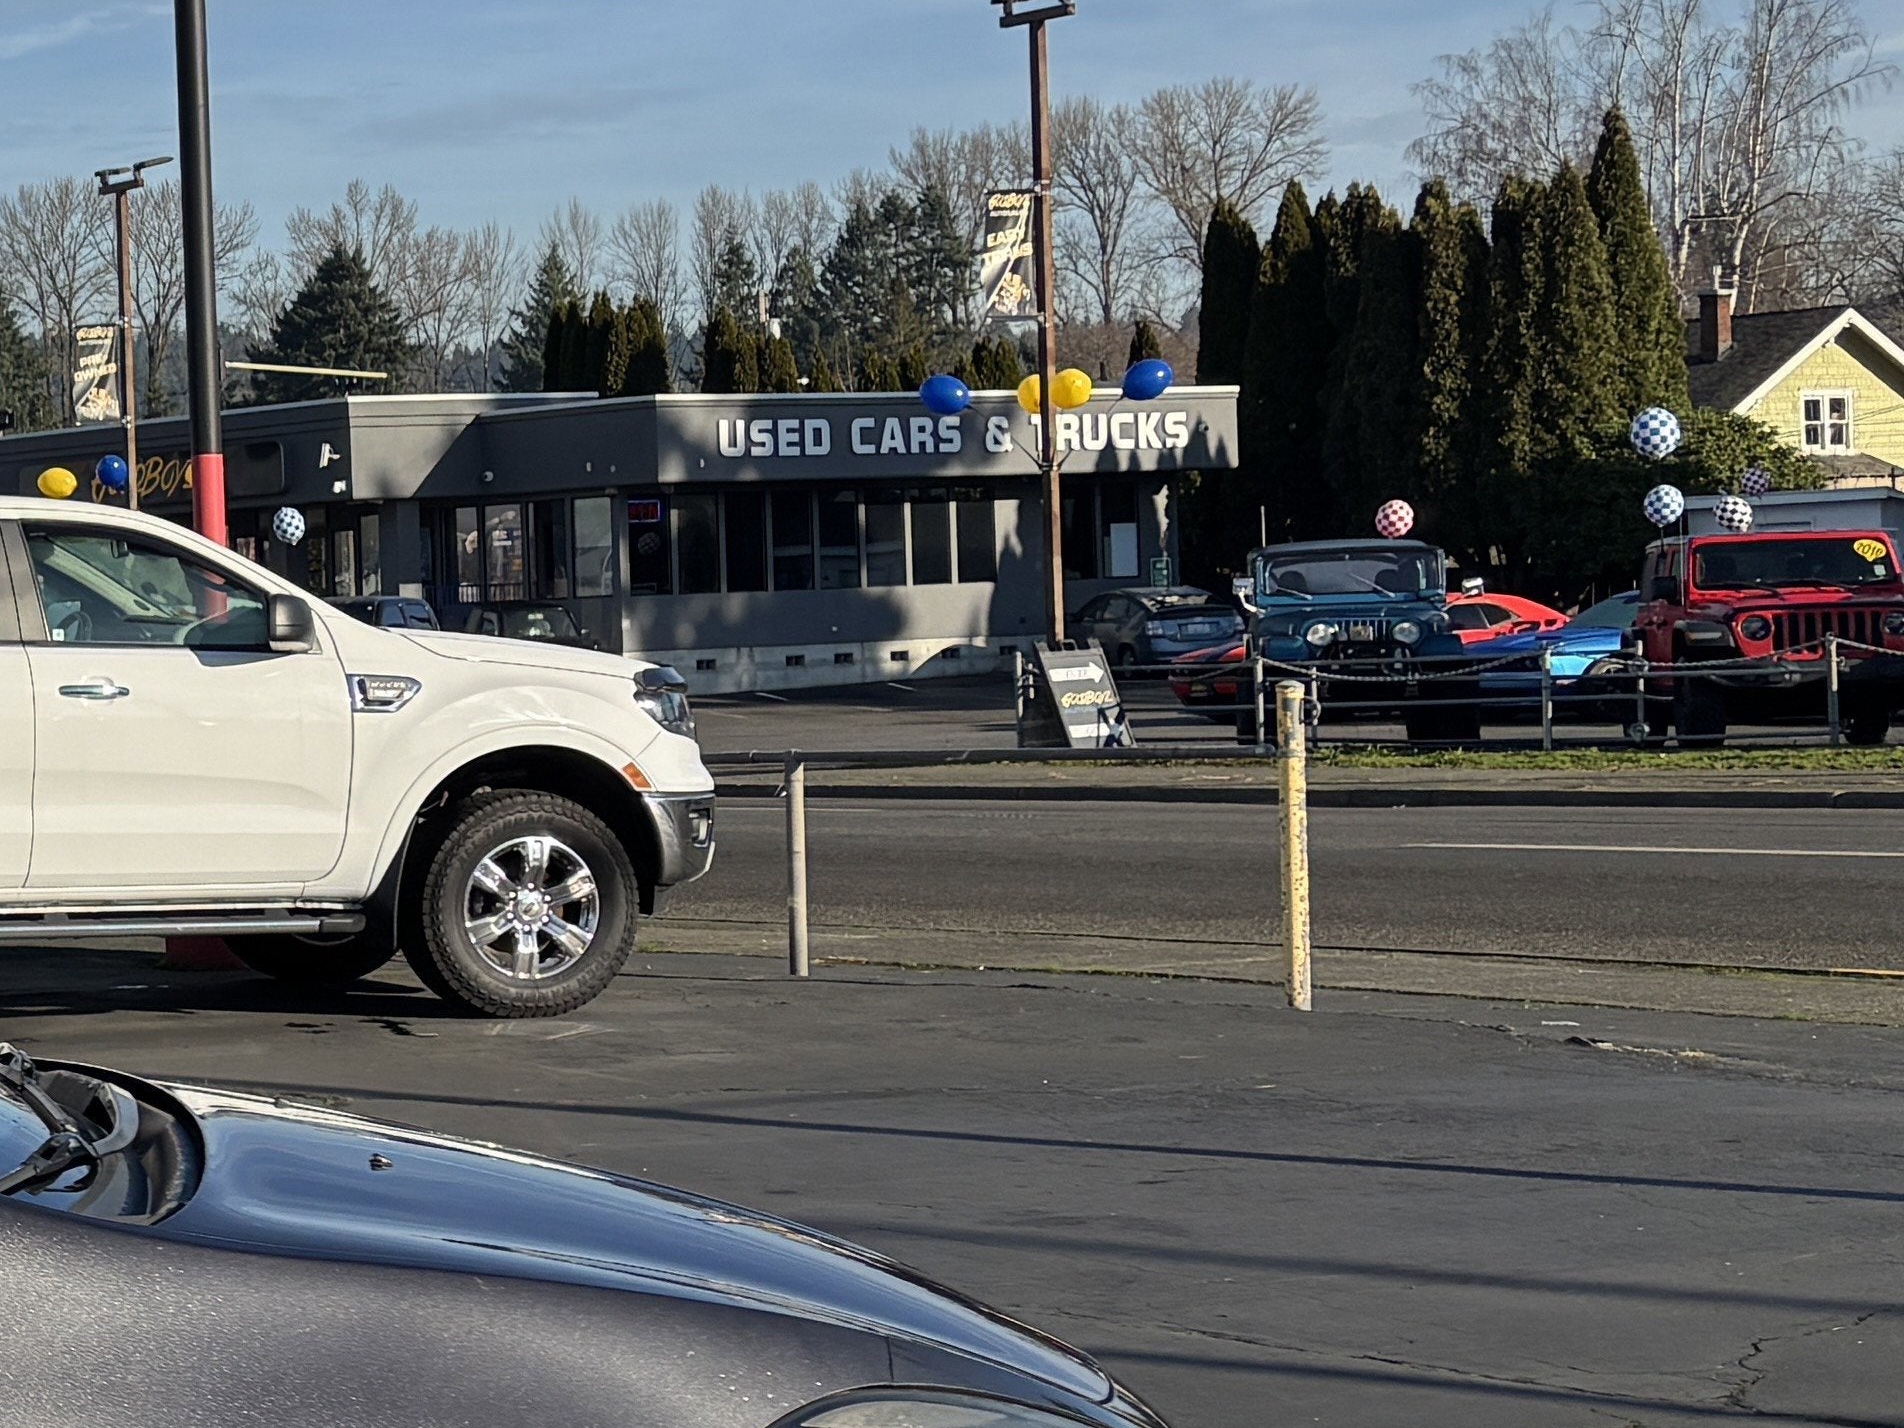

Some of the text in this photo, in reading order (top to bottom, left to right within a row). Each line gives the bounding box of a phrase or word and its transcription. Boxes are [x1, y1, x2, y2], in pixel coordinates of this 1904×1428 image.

[719, 418, 831, 458] USED
[851, 416, 961, 455] CARS
[985, 416, 1014, 453] &
